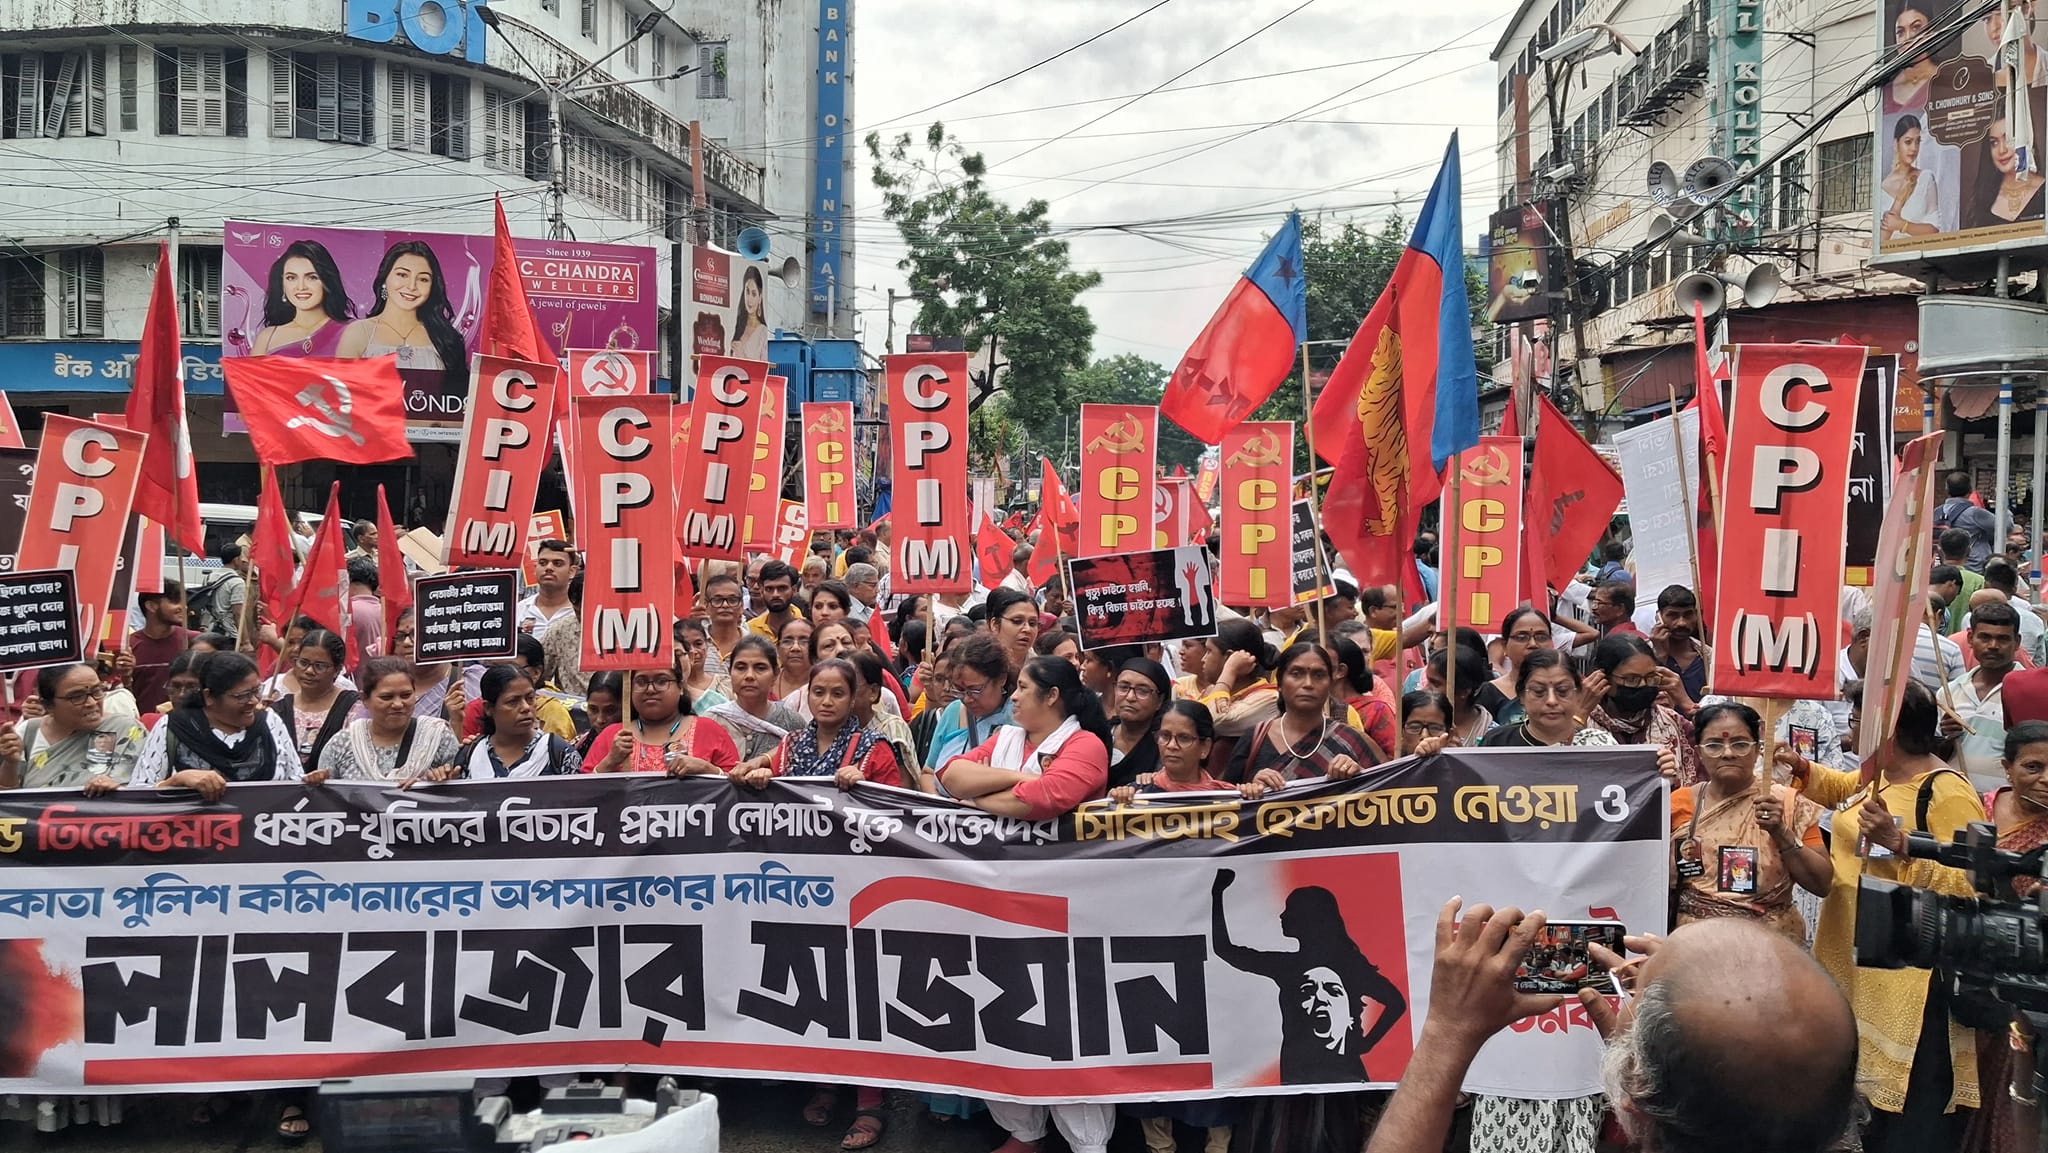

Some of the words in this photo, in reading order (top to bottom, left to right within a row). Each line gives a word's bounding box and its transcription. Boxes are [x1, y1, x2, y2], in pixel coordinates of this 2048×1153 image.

[825, 7, 839, 84] BANK
[824, 114, 838, 148] OF
[1977, 91, 1994, 102] SONS
[546, 248, 569, 257] Since
[571, 249, 592, 258] 1939
[820, 177, 835, 275] INDIA
[529, 299, 536, 307] A
[537, 300, 563, 310] jewel
[565, 300, 576, 309] of
[576, 302, 607, 312] jewels
[531, 280, 635, 295] WELLERS
[544, 262, 634, 282] CHANDRA
[54, 352, 93, 378] बैंक
[816, 441, 844, 523] CPI
[1237, 479, 1278, 598] CPI
[1462, 499, 1505, 625] CPI
[37, 804, 244, 852] তিলোত্তমার
[253, 797, 488, 860] ধর্ষক-খুনিদের
[496, 796, 606, 847] বিচার,
[619, 801, 718, 845] প্রমাণ
[728, 794, 834, 838] লোপাটে
[841, 804, 905, 854] যুক্ত
[1453, 784, 1580, 830] নেওয়া
[1593, 783, 1631, 824] ও
[113, 872, 230, 929] পুলিশ
[239, 870, 484, 918] কমিশনারের
[491, 873, 717, 917] অপসারণের
[724, 860, 836, 909] দাবিতে
[83, 922, 705, 1047] লালবাজার
[737, 876, 1212, 1062] অভিযান
